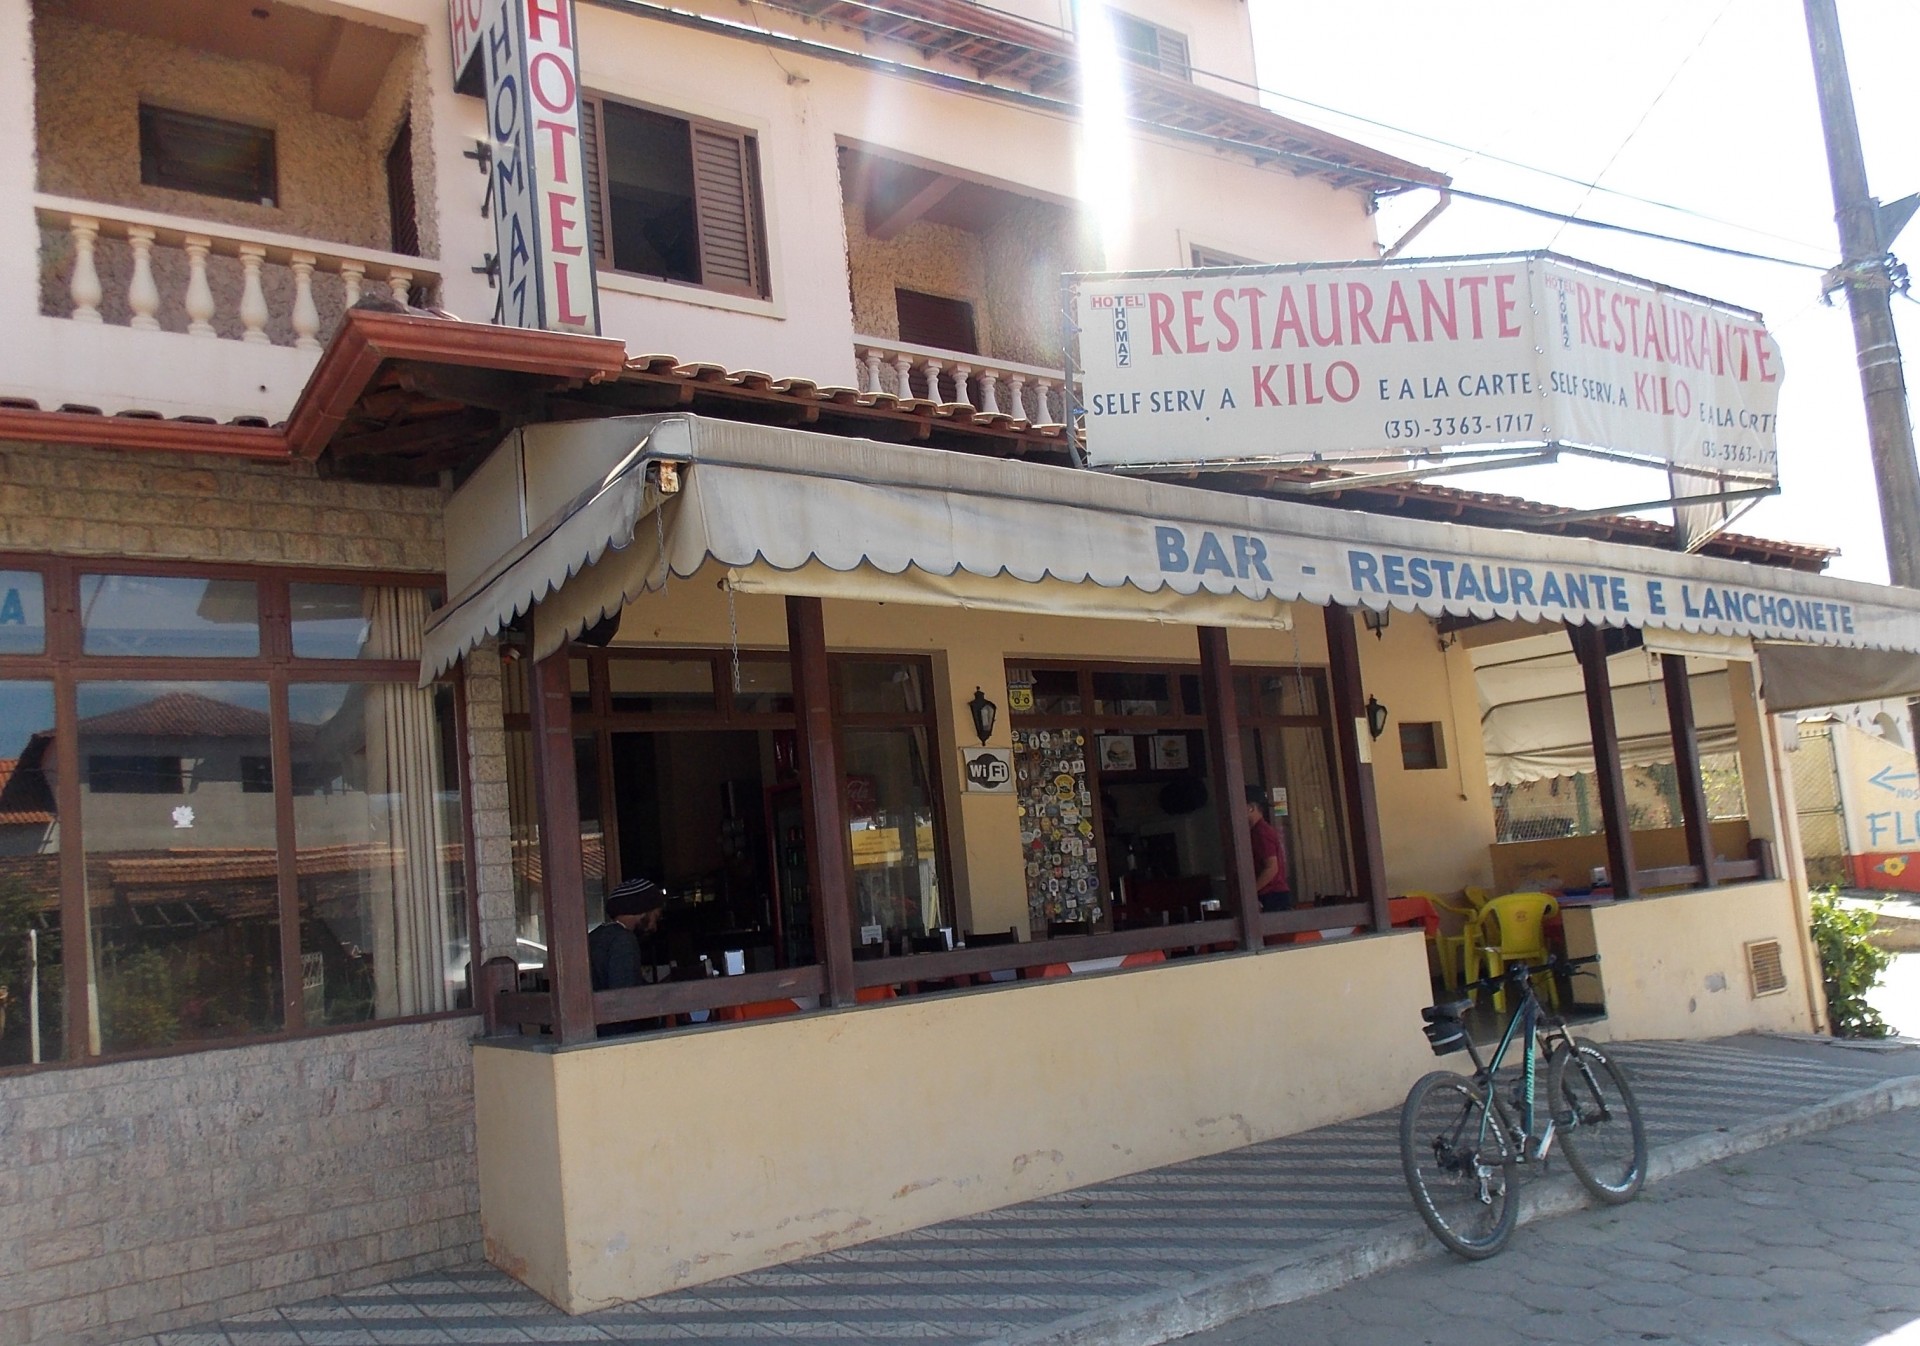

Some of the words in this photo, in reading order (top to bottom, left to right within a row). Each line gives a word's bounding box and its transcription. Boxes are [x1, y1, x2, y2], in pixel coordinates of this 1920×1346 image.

[527, 0, 587, 327] HOTEL
[1092, 296, 1143, 308] HOTEL
[1114, 296, 1129, 366] THOMAZ
[1149, 275, 1522, 356] RESTAURANTE
[1575, 281, 1777, 383] RESTAURANTE
[1093, 391, 1141, 417] SELF
[1221, 388, 1236, 409] A
[1252, 360, 1361, 409] KILO
[1379, 380, 1391, 401] E
[1399, 379, 1415, 400] A
[1423, 376, 1449, 399] LA
[1459, 373, 1532, 397] CARTE
[1550, 370, 1577, 396] SELF
[1619, 390, 1628, 408] A
[1634, 371, 1691, 418] KILO
[1716, 407, 1734, 428] LA
[1384, 414, 1535, 438] (35)-3363-1717
[1155, 526, 1273, 581] BAR
[1348, 550, 1629, 613] RESTAURANTE
[1647, 581, 1666, 615] E
[1682, 585, 1855, 635] LANCHONETE
